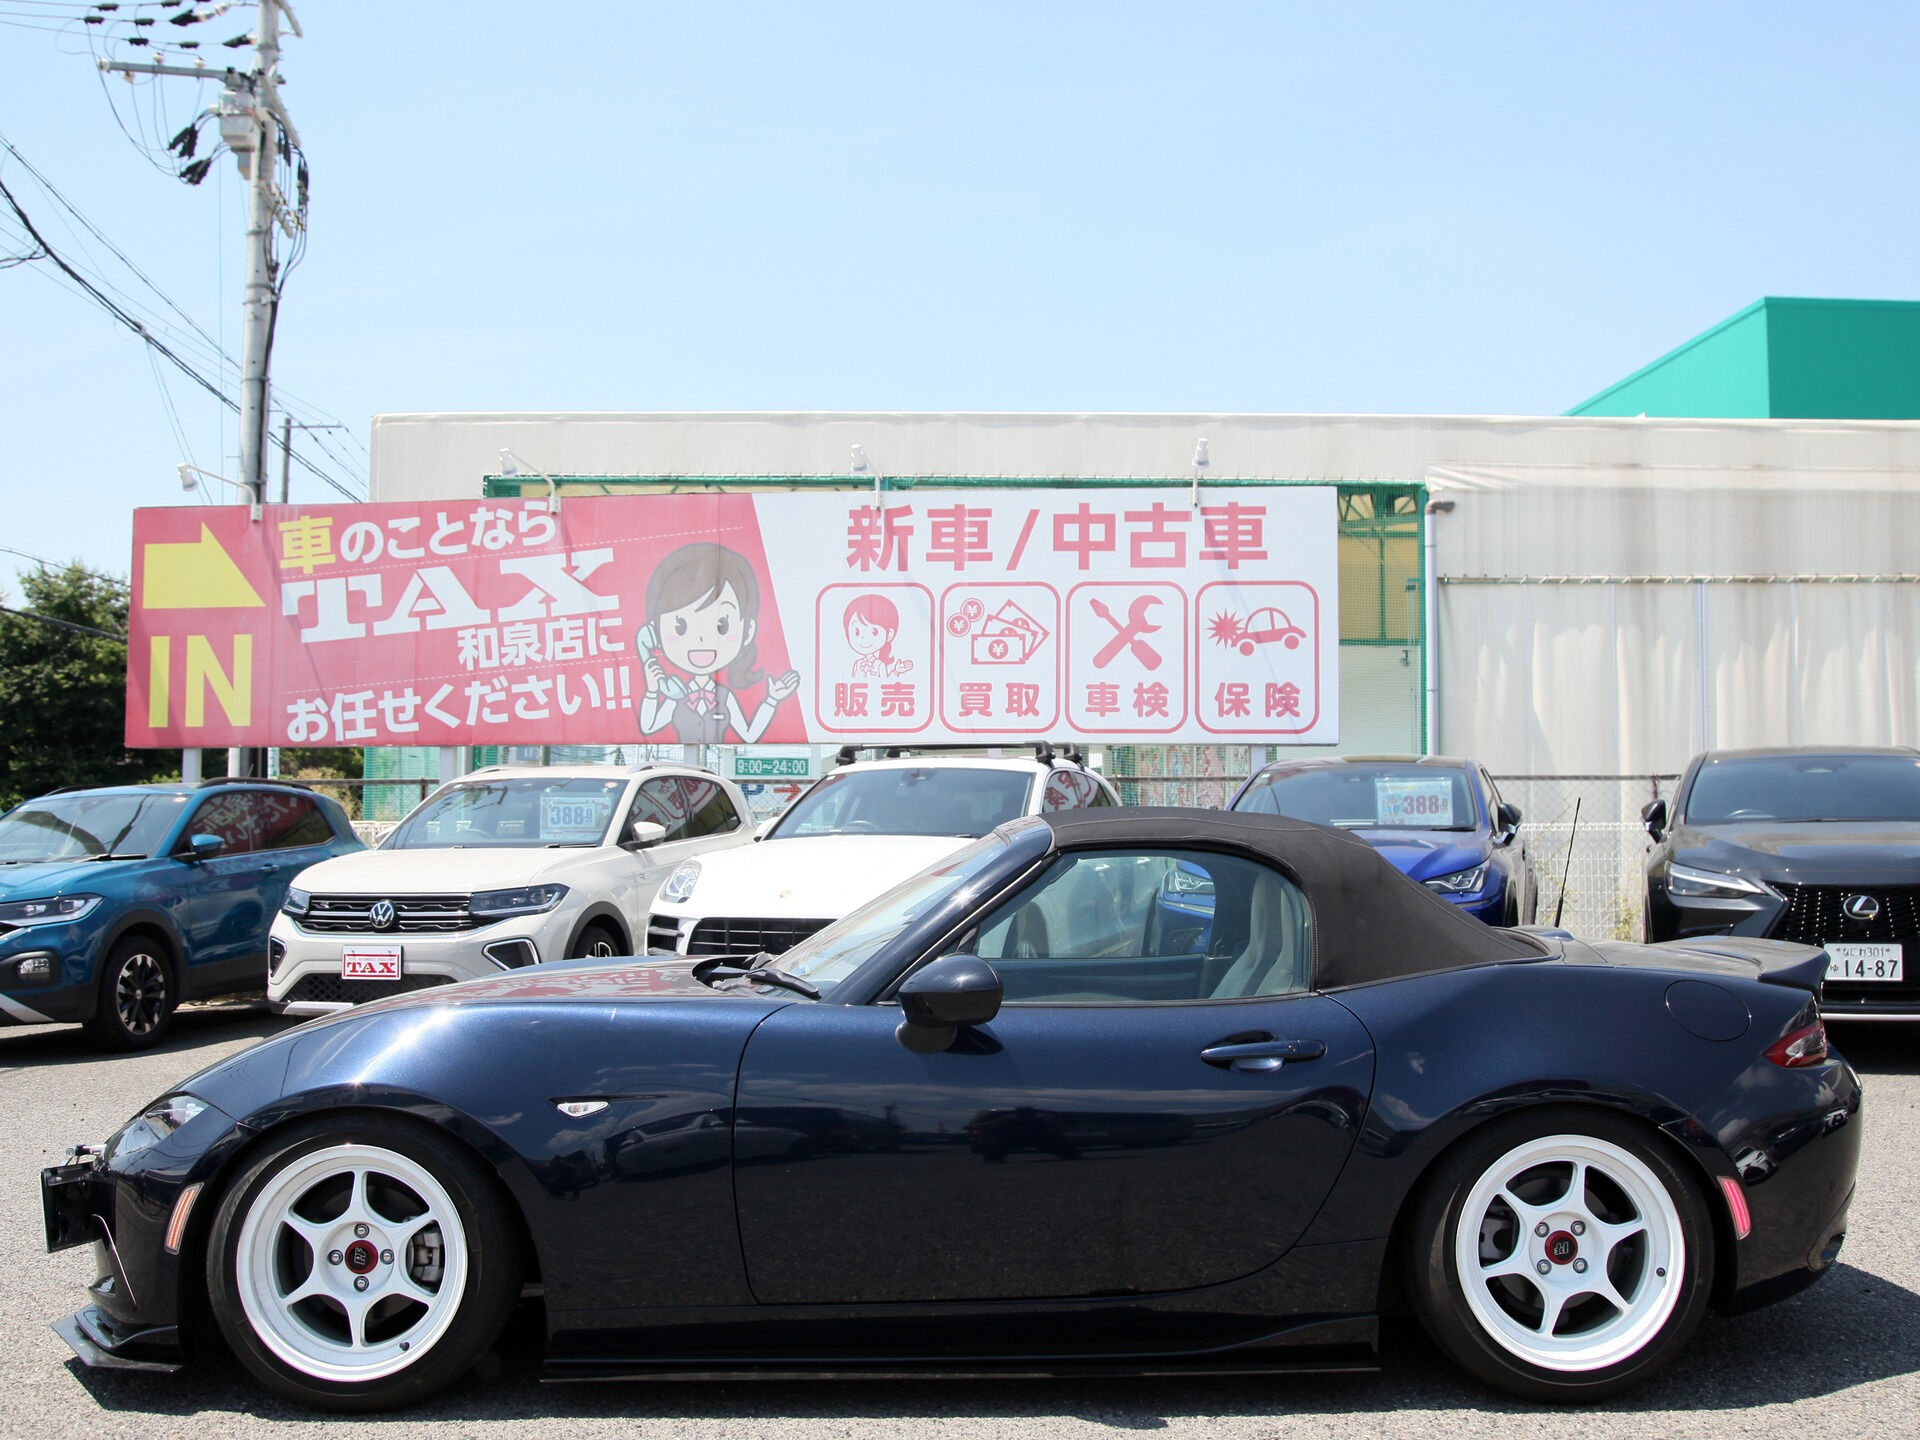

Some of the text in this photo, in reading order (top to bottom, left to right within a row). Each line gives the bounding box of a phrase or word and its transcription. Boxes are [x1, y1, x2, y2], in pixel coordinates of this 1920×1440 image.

[279, 501, 556, 574] 車のことなら
[846, 501, 1268, 572] 新車/中古車
[282, 548, 620, 644] TAX
[457, 617, 625, 670] 和泉店に
[149, 634, 253, 728] IN
[834, 682, 917, 718] 販売
[958, 682, 1040, 718] 買取
[1085, 681, 1170, 718] 車検
[1214, 681, 1301, 718] 保険
[286, 666, 632, 743] お任せください!!
[346, 962, 396, 973] TAX
[1844, 959, 1898, 978] 14-87
